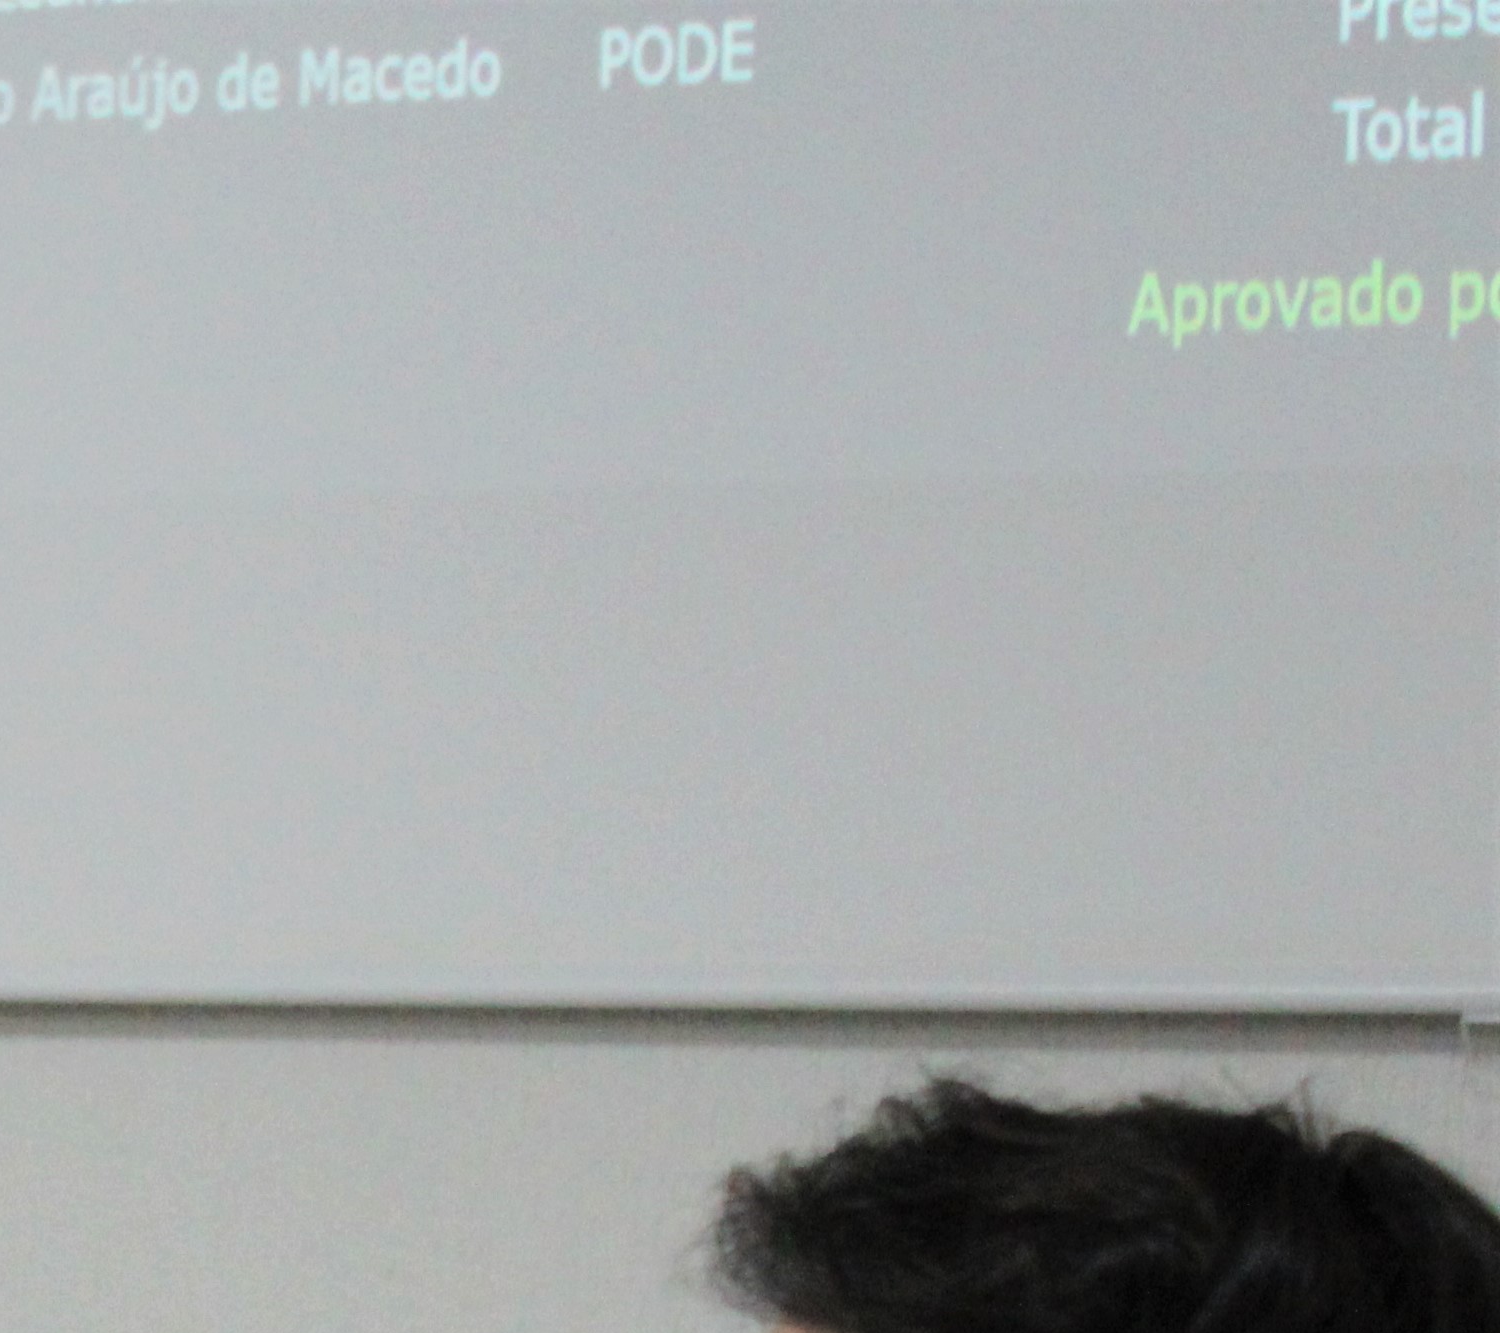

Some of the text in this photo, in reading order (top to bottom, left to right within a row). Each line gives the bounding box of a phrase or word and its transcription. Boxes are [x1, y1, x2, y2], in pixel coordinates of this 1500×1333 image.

[30, 55, 200, 131] Araújo
[217, 50, 281, 112] de
[301, 37, 503, 106] Macedo
[598, 19, 755, 90] PODE
[1331, 89, 1486, 164] Total
[1127, 257, 1425, 348] Aprovado
